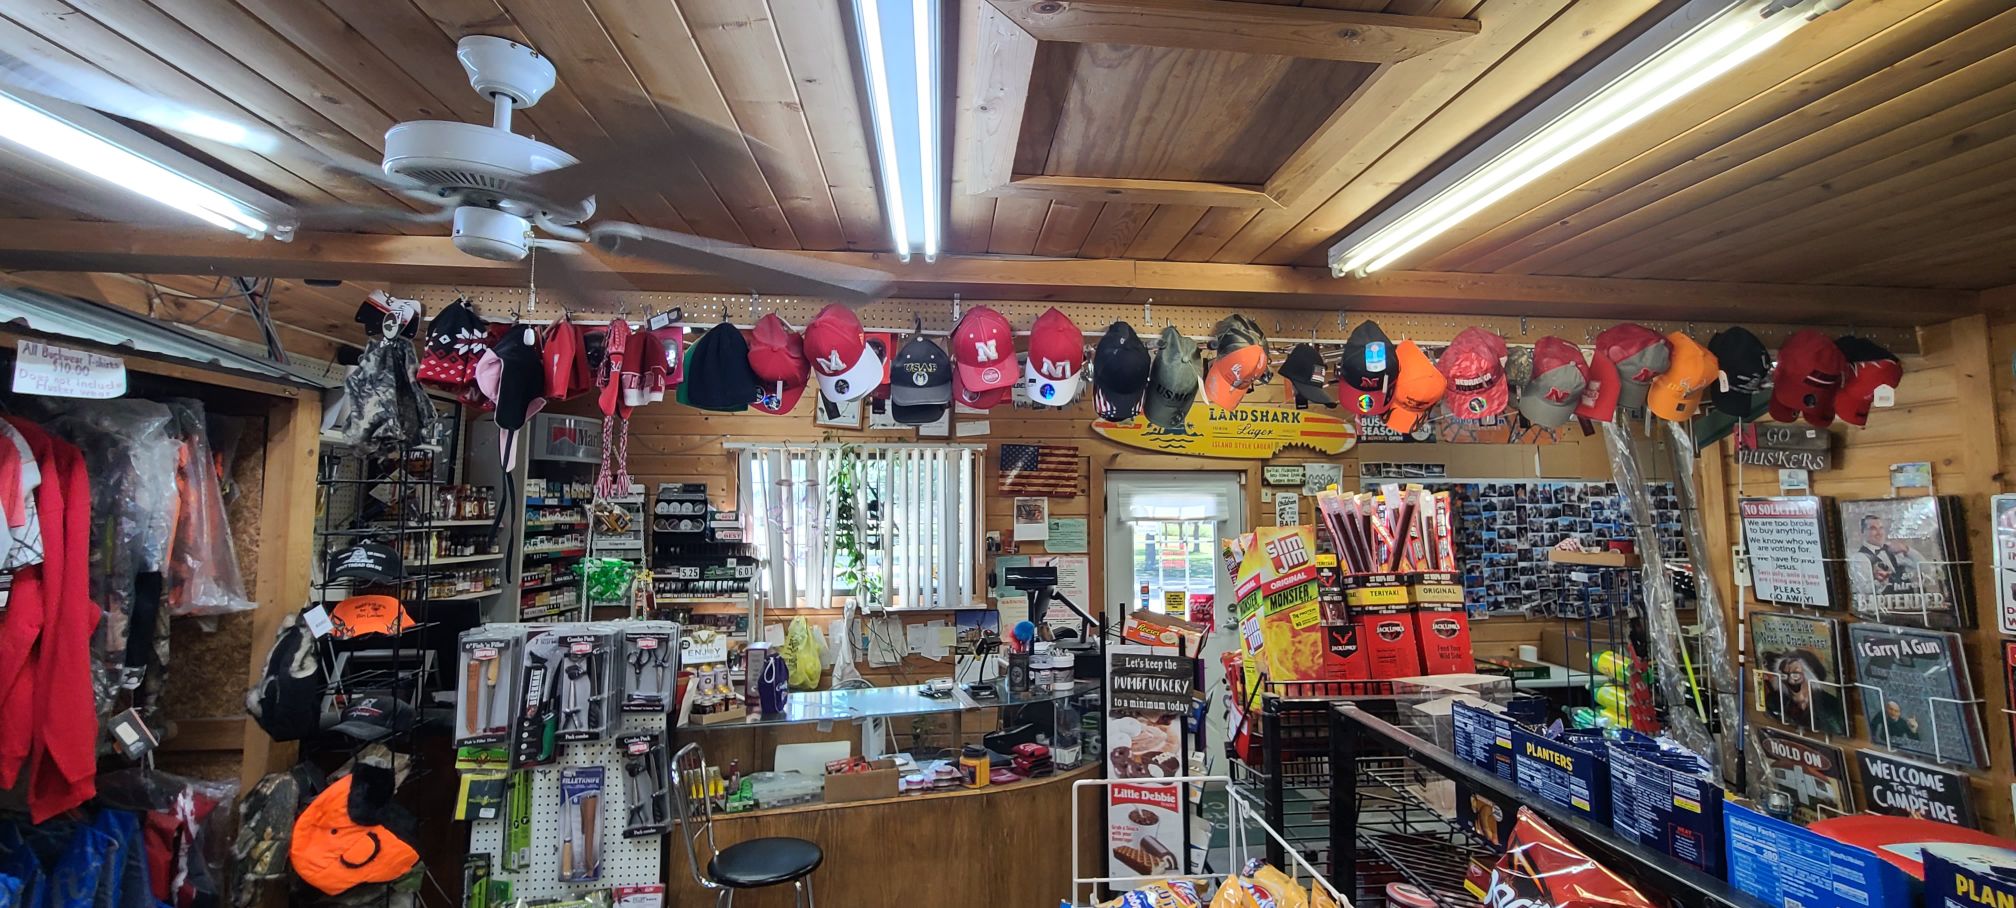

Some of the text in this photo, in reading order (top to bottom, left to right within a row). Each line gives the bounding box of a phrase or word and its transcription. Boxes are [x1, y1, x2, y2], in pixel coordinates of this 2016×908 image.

[22, 343, 38, 357] All
[975, 339, 999, 362] N
[53, 359, 90, 376] $10.00
[1209, 408, 1300, 423] LANDSHARK
[1361, 418, 1386, 427] BUSC
[1237, 424, 1274, 439] Lager
[1767, 428, 1790, 446] GO
[1740, 450, 1825, 470] HUSKERS
[1744, 504, 1757, 515] NO
[1759, 527, 1773, 535] buy
[1776, 528, 1814, 536] anything.
[1771, 545, 1797, 553] voting
[1791, 555, 1816, 563] fond
[1270, 572, 1307, 590] ORIGINAL
[1785, 594, 1814, 603] AWY!
[1858, 639, 1940, 659] I Carry A Gun
[1125, 657, 1177, 671] Let's keep the
[1114, 697, 1189, 714] to a minimum today
[1526, 742, 1574, 771] PLANTERS
[1770, 741, 1822, 768] HOLD ON
[1865, 757, 1945, 792] WELCOME
[1113, 788, 1176, 803] Little Debbie
[1889, 782, 1928, 798] TO THE
[1872, 785, 1958, 824] CAMPFIRE
